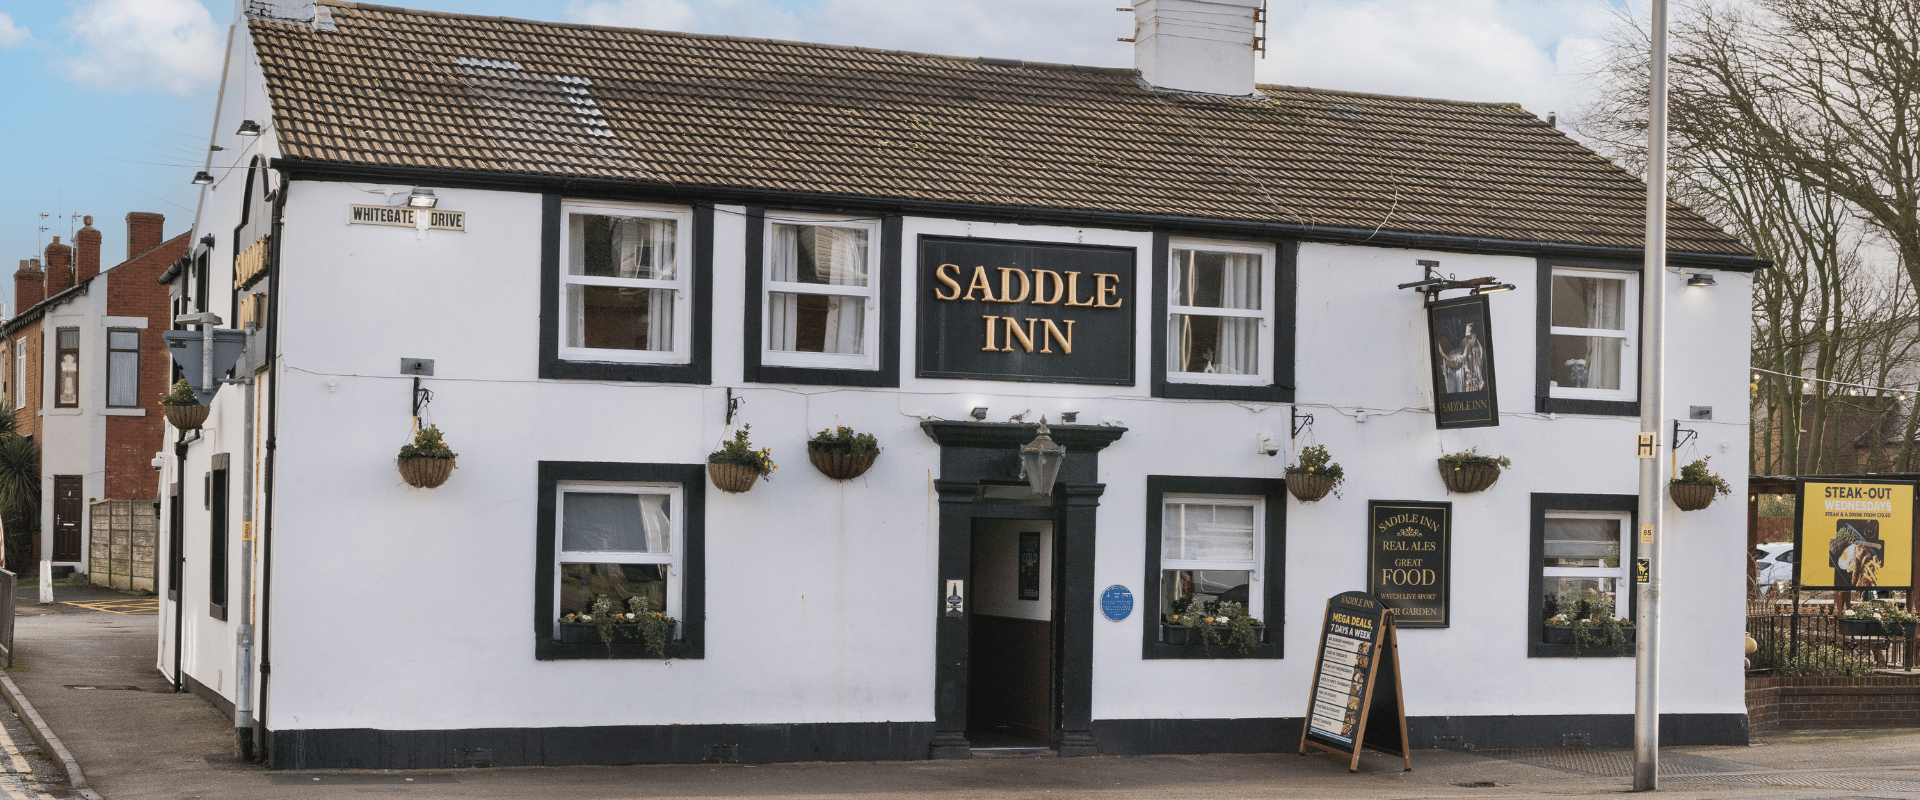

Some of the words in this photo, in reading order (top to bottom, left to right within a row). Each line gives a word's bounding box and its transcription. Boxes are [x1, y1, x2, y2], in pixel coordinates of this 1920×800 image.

[353, 206, 414, 224] WHITEGATE
[431, 212, 462, 228] DRIVE
[935, 263, 1123, 308] SADDLE
[981, 315, 1076, 355] INN
[1442, 401, 1471, 412] SADDLE
[1473, 399, 1487, 409] INN
[1824, 486, 1892, 499] STEAK-OUT
[1824, 500, 1892, 511] WEDNESDAYS
[1378, 513, 1419, 533] SADDLE
[1420, 515, 1440, 533] INN
[1382, 540, 1409, 551] REAL
[1410, 541, 1436, 551] ALES
[1394, 558, 1423, 567] GREAT
[1381, 568, 1436, 586] FOOD
[1340, 595, 1364, 607] SADDLE
[1363, 599, 1375, 609] INN
[1402, 607, 1437, 616] GARDEN
[1332, 612, 1350, 625] MEGA
[1350, 616, 1373, 631] DEALS,
[1330, 623, 1335, 632] 7
[1334, 624, 1349, 635] DAYS
[1348, 627, 1354, 636] A
[1354, 628, 1372, 640] WEEK
